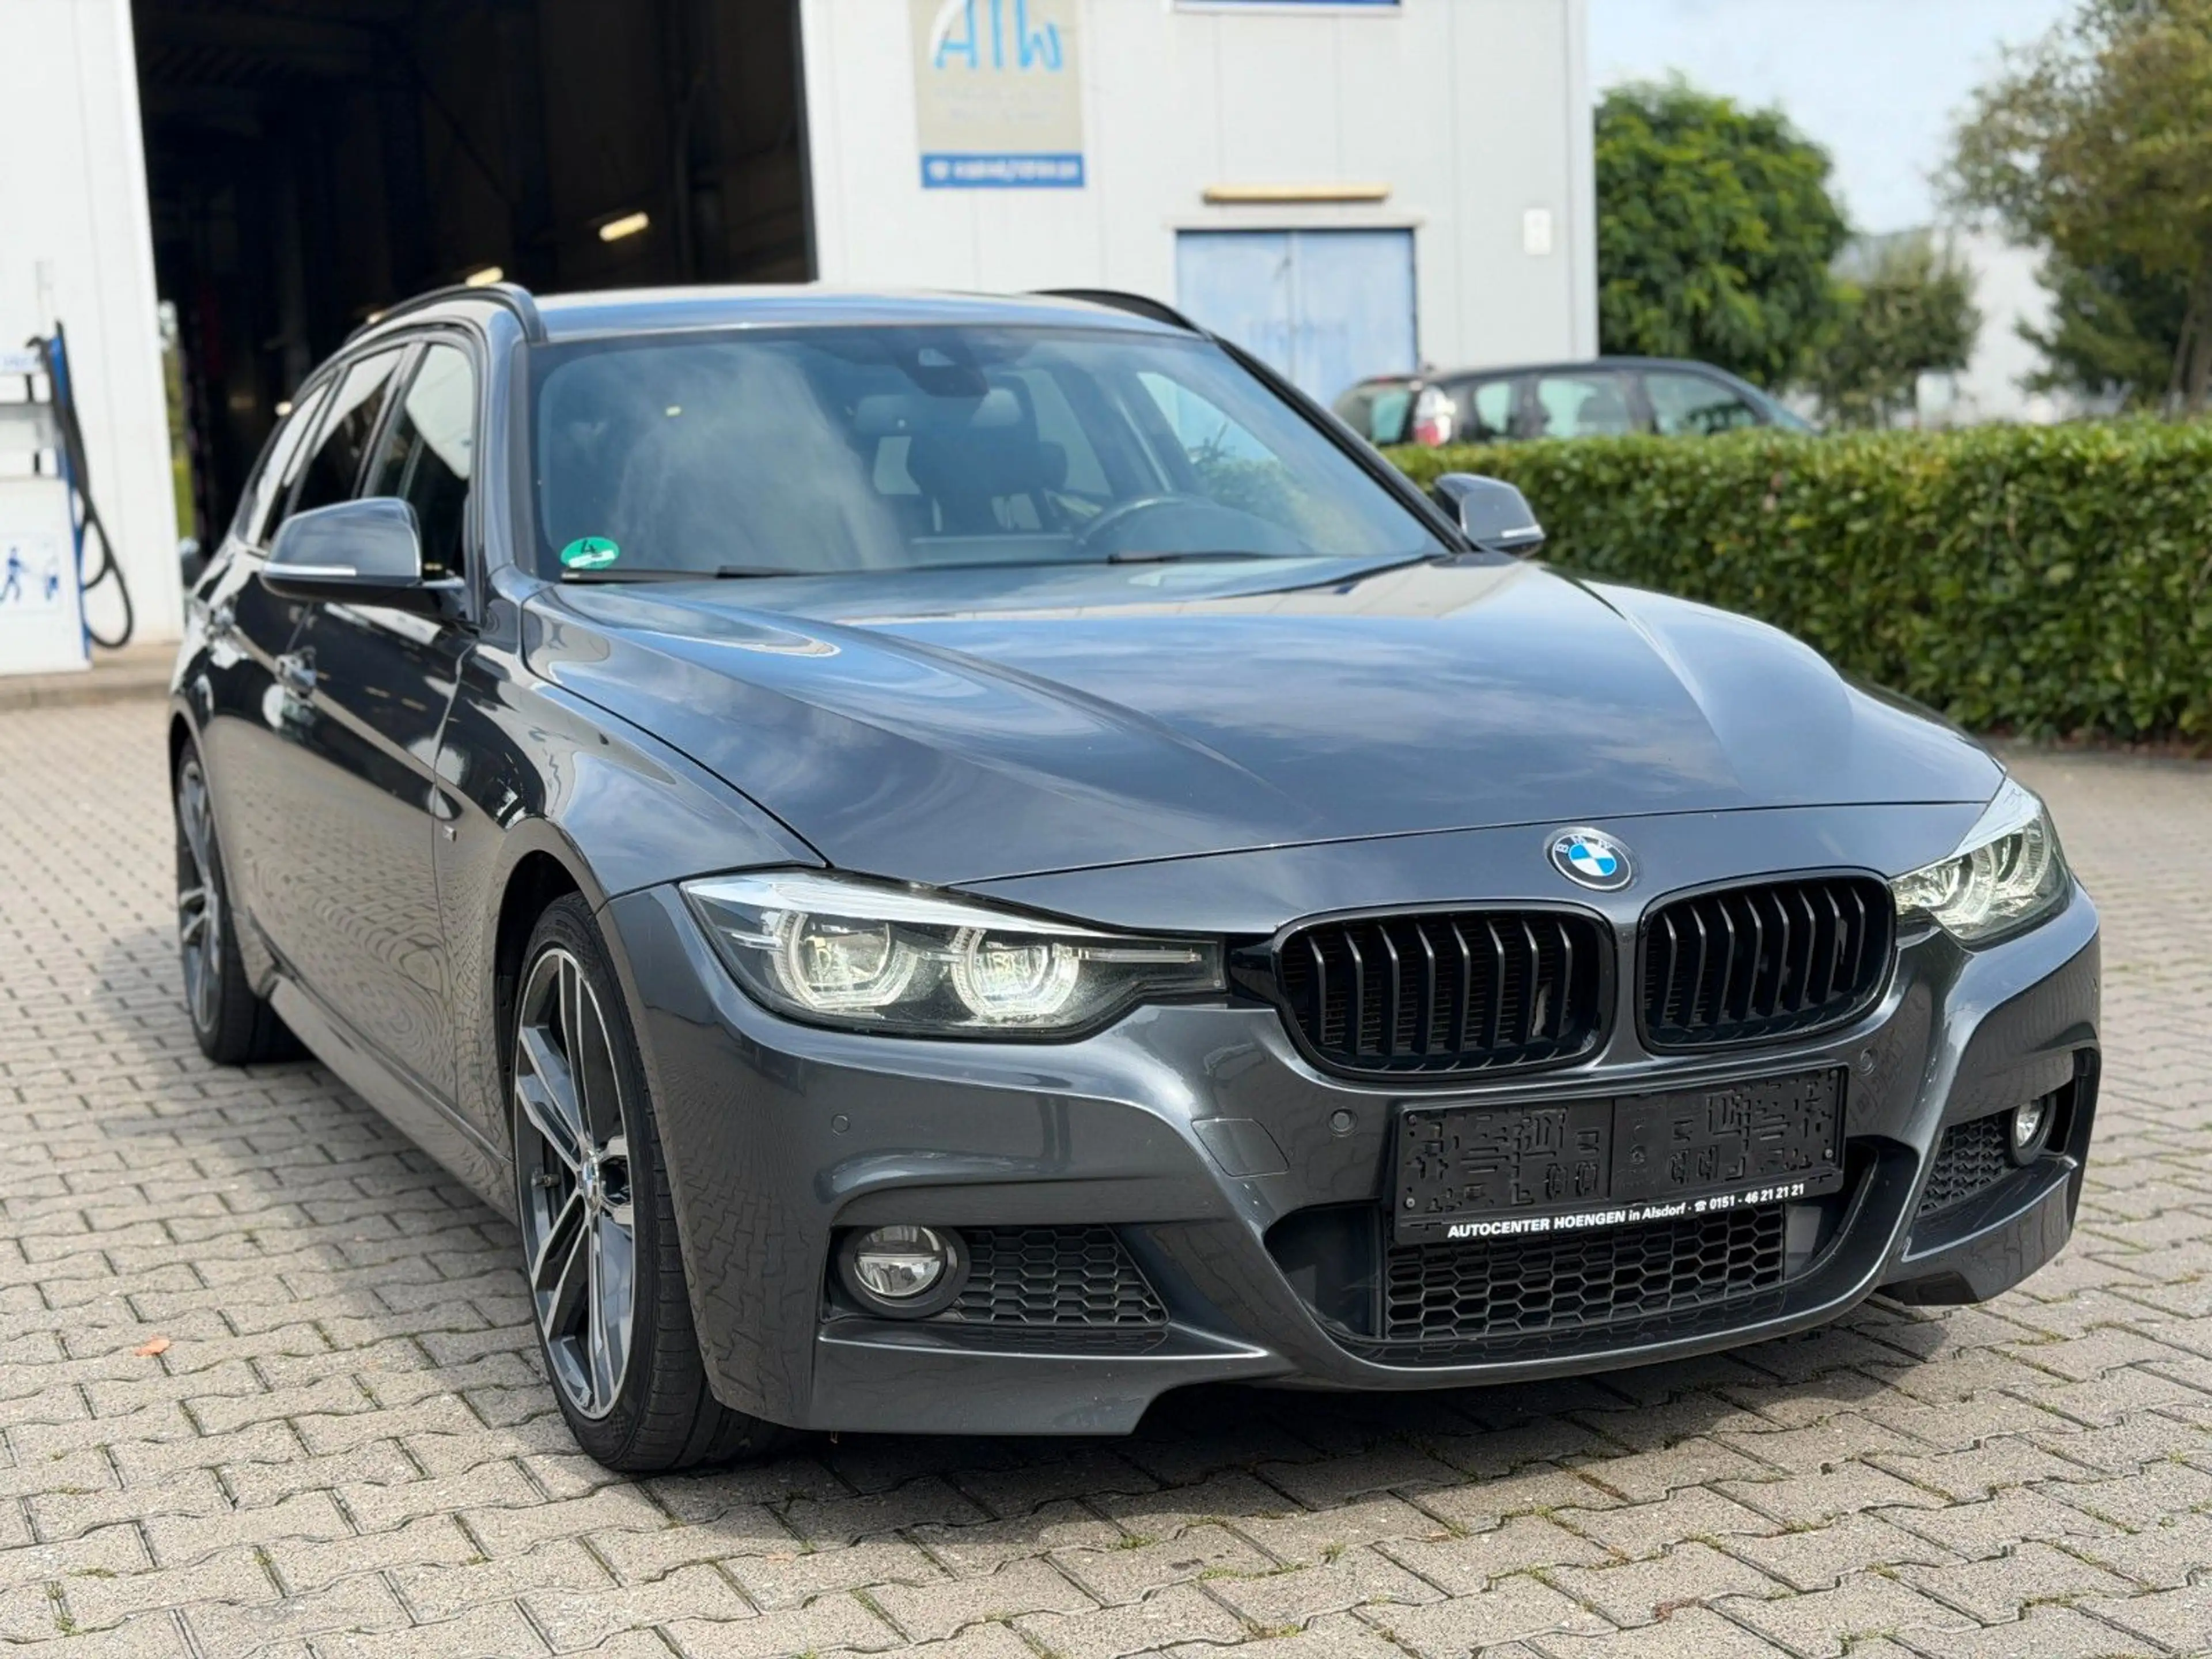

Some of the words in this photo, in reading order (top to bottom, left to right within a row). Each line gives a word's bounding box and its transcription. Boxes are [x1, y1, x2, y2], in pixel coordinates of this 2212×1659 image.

[1555, 835, 1613, 854] BMW
[1447, 1218, 1550, 1238] AUTOCENTER
[1554, 1210, 1626, 1229] HOENGEN
[1628, 1210, 1641, 1221] in
[1642, 1202, 1687, 1220] Alsdorf
[1709, 1194, 1735, 1210] 0151
[1744, 1191, 1759, 1204] 46
[1760, 1188, 1774, 1202] 21
[1775, 1185, 1789, 1199] 21
[1791, 1183, 1804, 1196] 21
